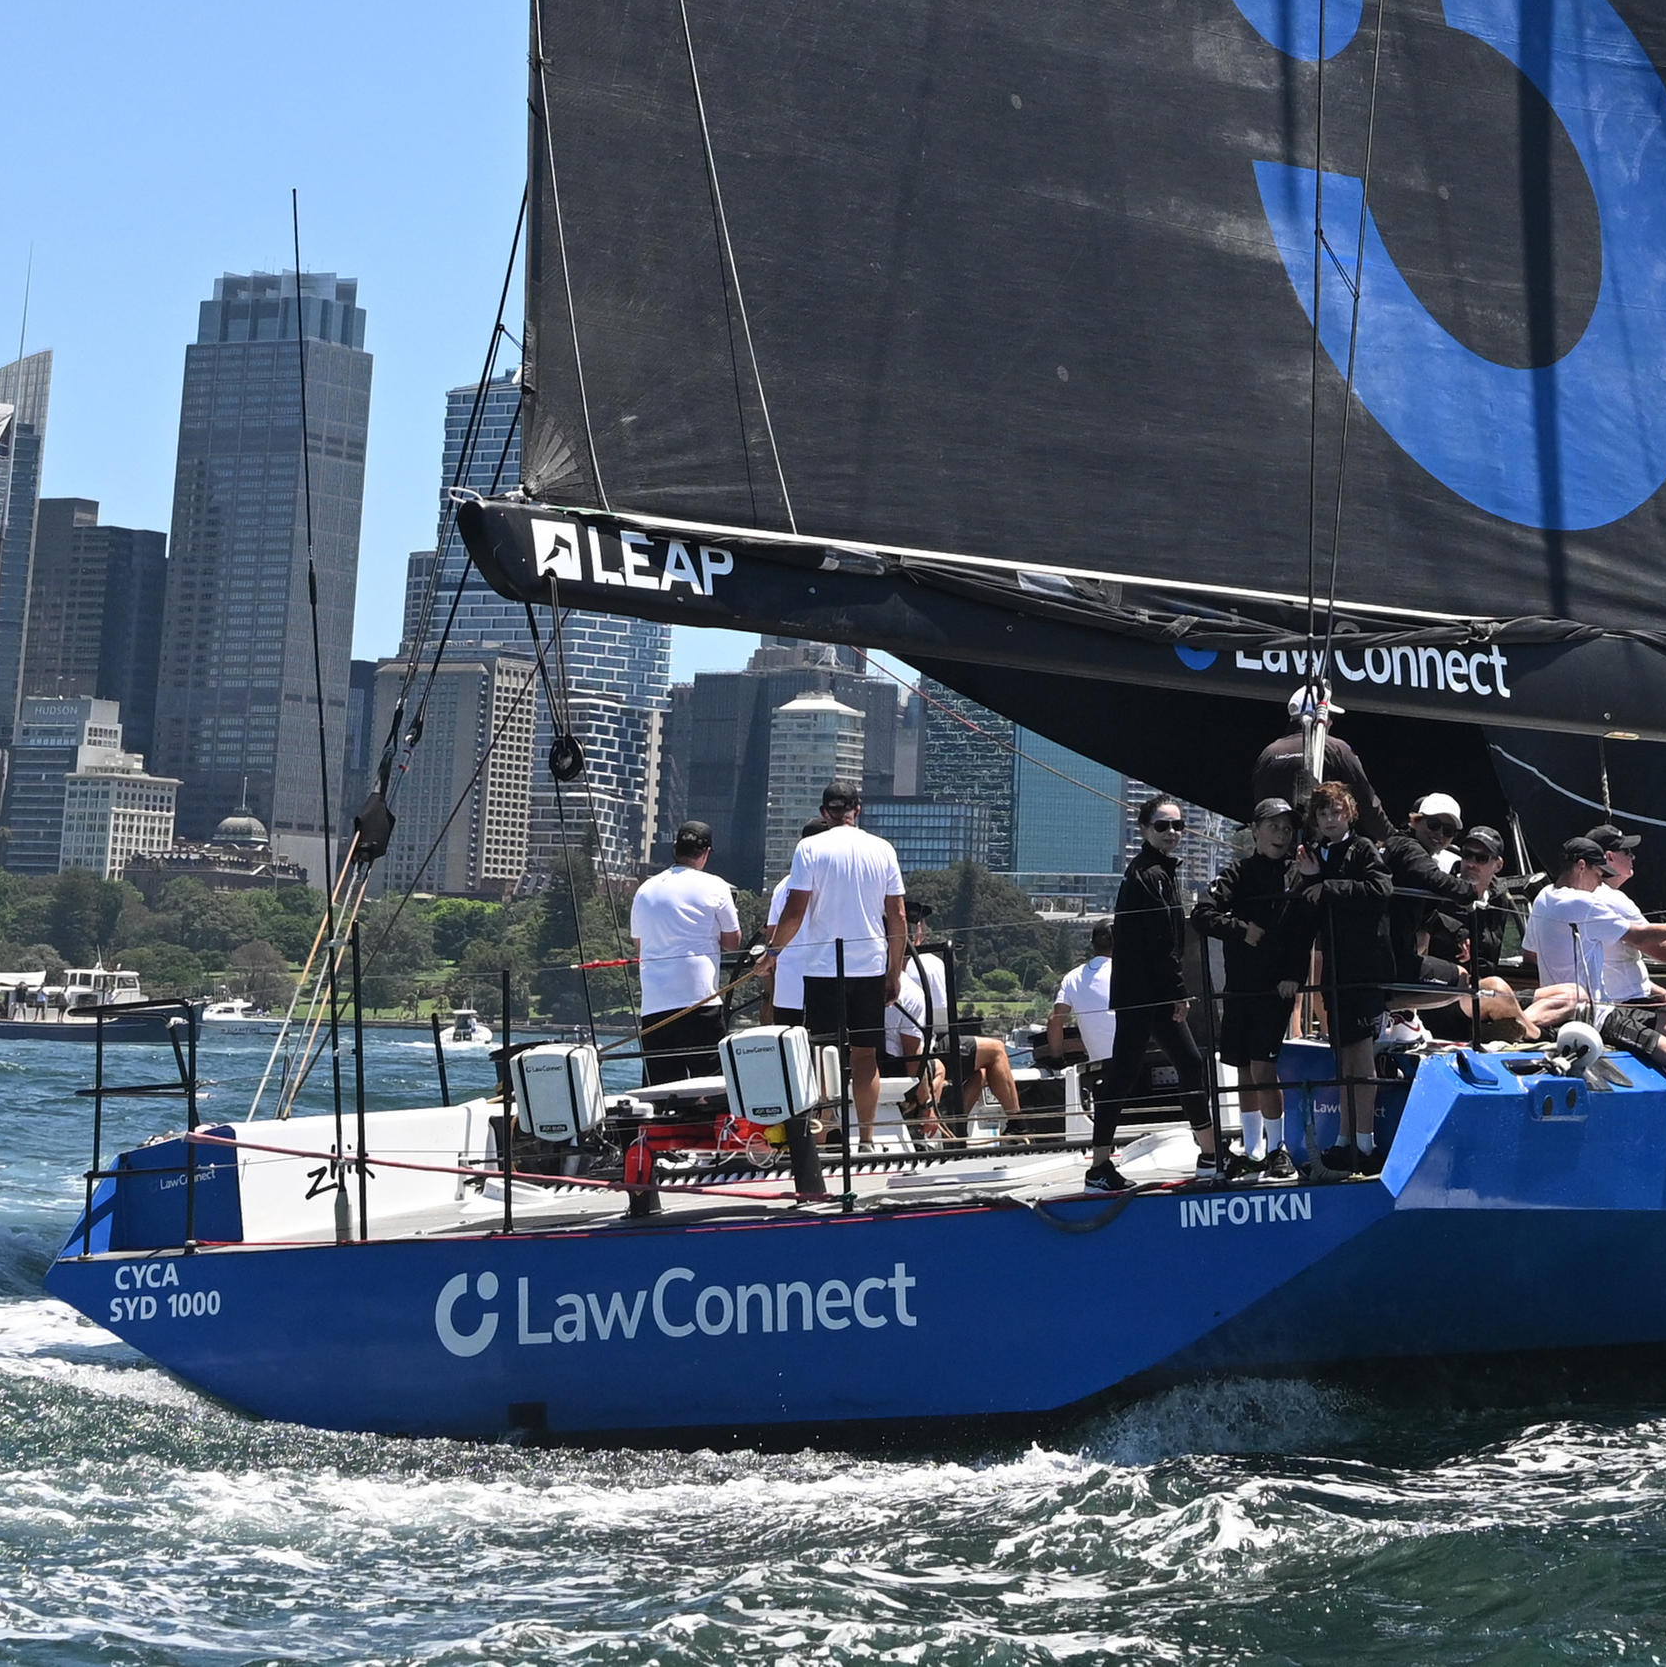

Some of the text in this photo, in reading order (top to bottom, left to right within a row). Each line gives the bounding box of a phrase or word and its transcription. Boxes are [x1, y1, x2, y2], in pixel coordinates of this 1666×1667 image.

[587, 525, 734, 596] LEAP
[34, 705, 78, 715] HUDSON
[1180, 1192, 1312, 1228] INFOTKN
[114, 1262, 180, 1291] CYCA
[109, 1290, 222, 1322] SYD 1000
[517, 1262, 918, 1345] LawConnect
